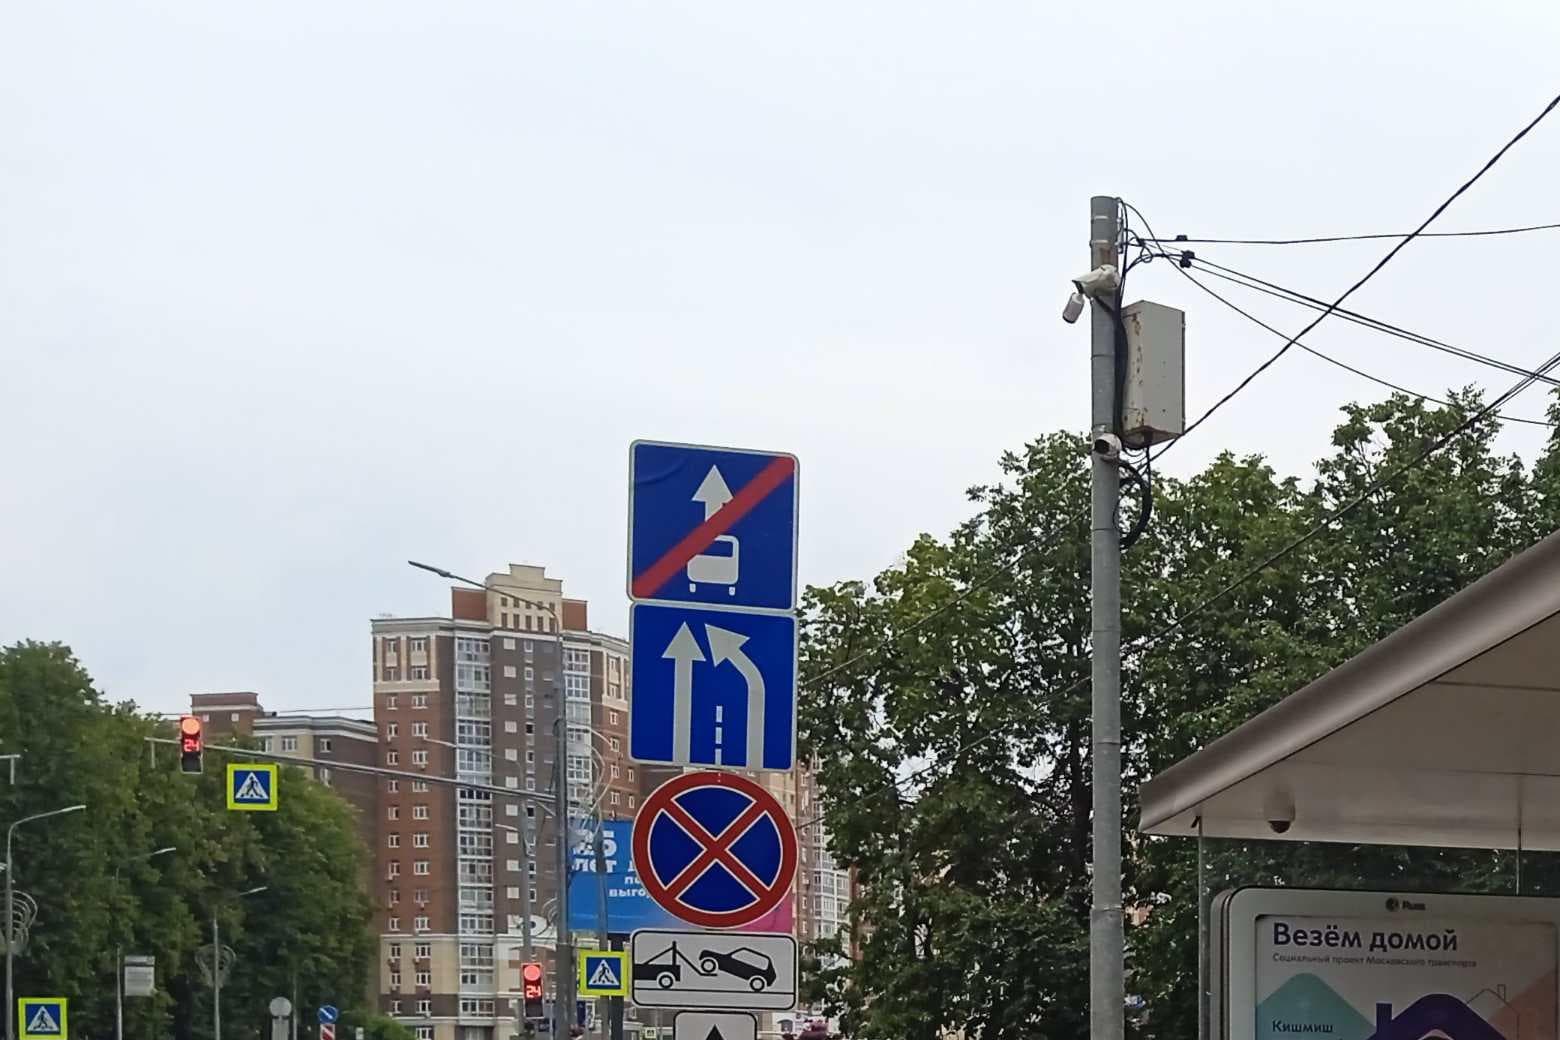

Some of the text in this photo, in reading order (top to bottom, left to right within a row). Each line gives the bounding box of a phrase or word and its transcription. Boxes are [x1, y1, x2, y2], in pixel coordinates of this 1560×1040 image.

[184, 739, 200, 752] 24
[609, 888, 650, 898] выго
[1273, 922, 1458, 952] Везём домой
[1273, 953, 1477, 969] Социальный проект Московского транспорта
[525, 985, 542, 998] 24
[1272, 1020, 1333, 1033] Кишмиш
